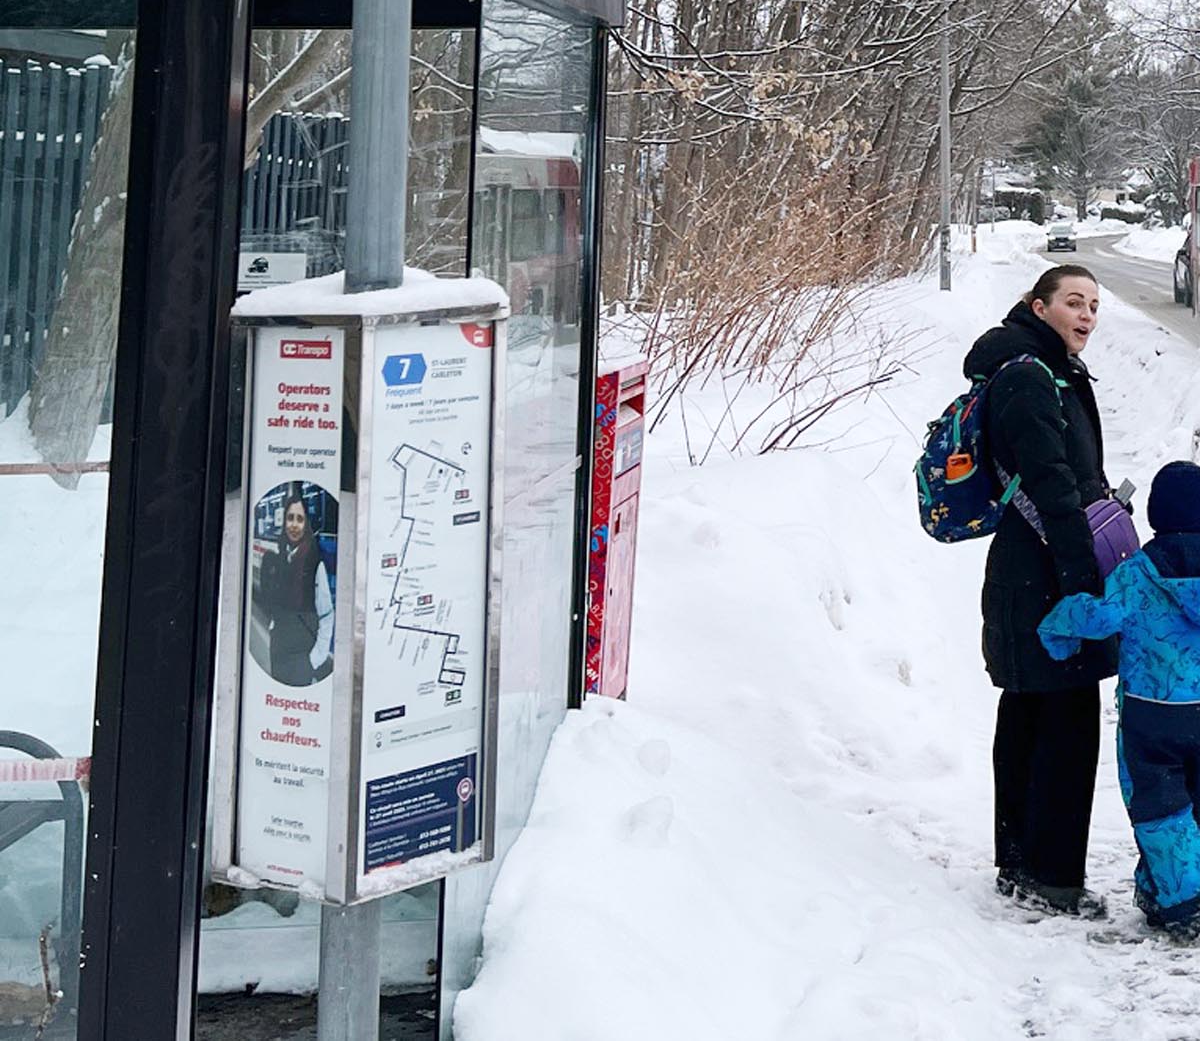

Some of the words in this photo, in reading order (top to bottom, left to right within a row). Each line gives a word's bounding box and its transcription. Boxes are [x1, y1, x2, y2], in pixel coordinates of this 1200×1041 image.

[297, 344, 330, 358] Transpo
[399, 358, 411, 379] 7
[278, 382, 331, 396] Operators
[278, 399, 319, 412] deserve
[323, 403, 329, 412] a
[267, 415, 289, 427] safe
[293, 416, 314, 428] ride
[318, 418, 339, 430] too.
[268, 444, 292, 454] Respect
[293, 446, 308, 457] your
[309, 447, 336, 457] operator
[277, 459, 294, 468] while
[296, 461, 304, 469] on
[265, 693, 320, 712] Respectez
[282, 715, 301, 727] nos
[260, 729, 321, 748] chauffeurs.
